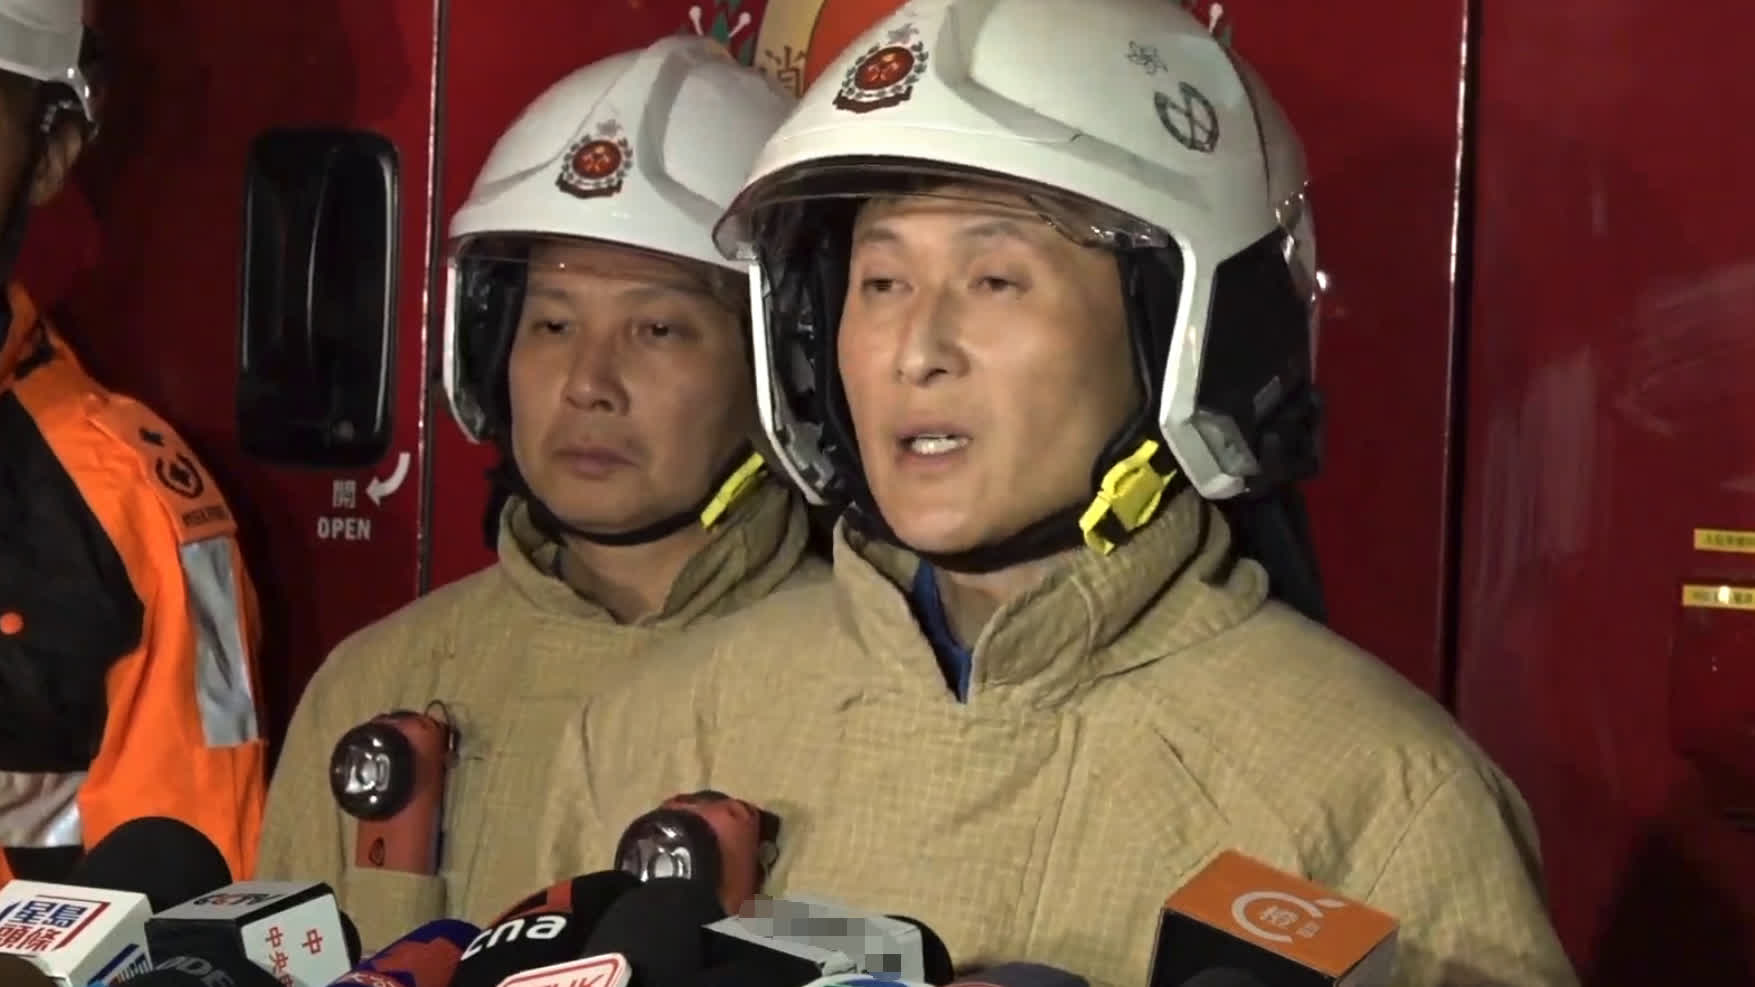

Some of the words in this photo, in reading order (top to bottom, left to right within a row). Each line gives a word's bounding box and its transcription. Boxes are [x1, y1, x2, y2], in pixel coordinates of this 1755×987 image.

[332, 480, 356, 508] 開
[317, 517, 371, 540] OPEN
[8, 900, 88, 928] 星島
[461, 915, 566, 960] cna
